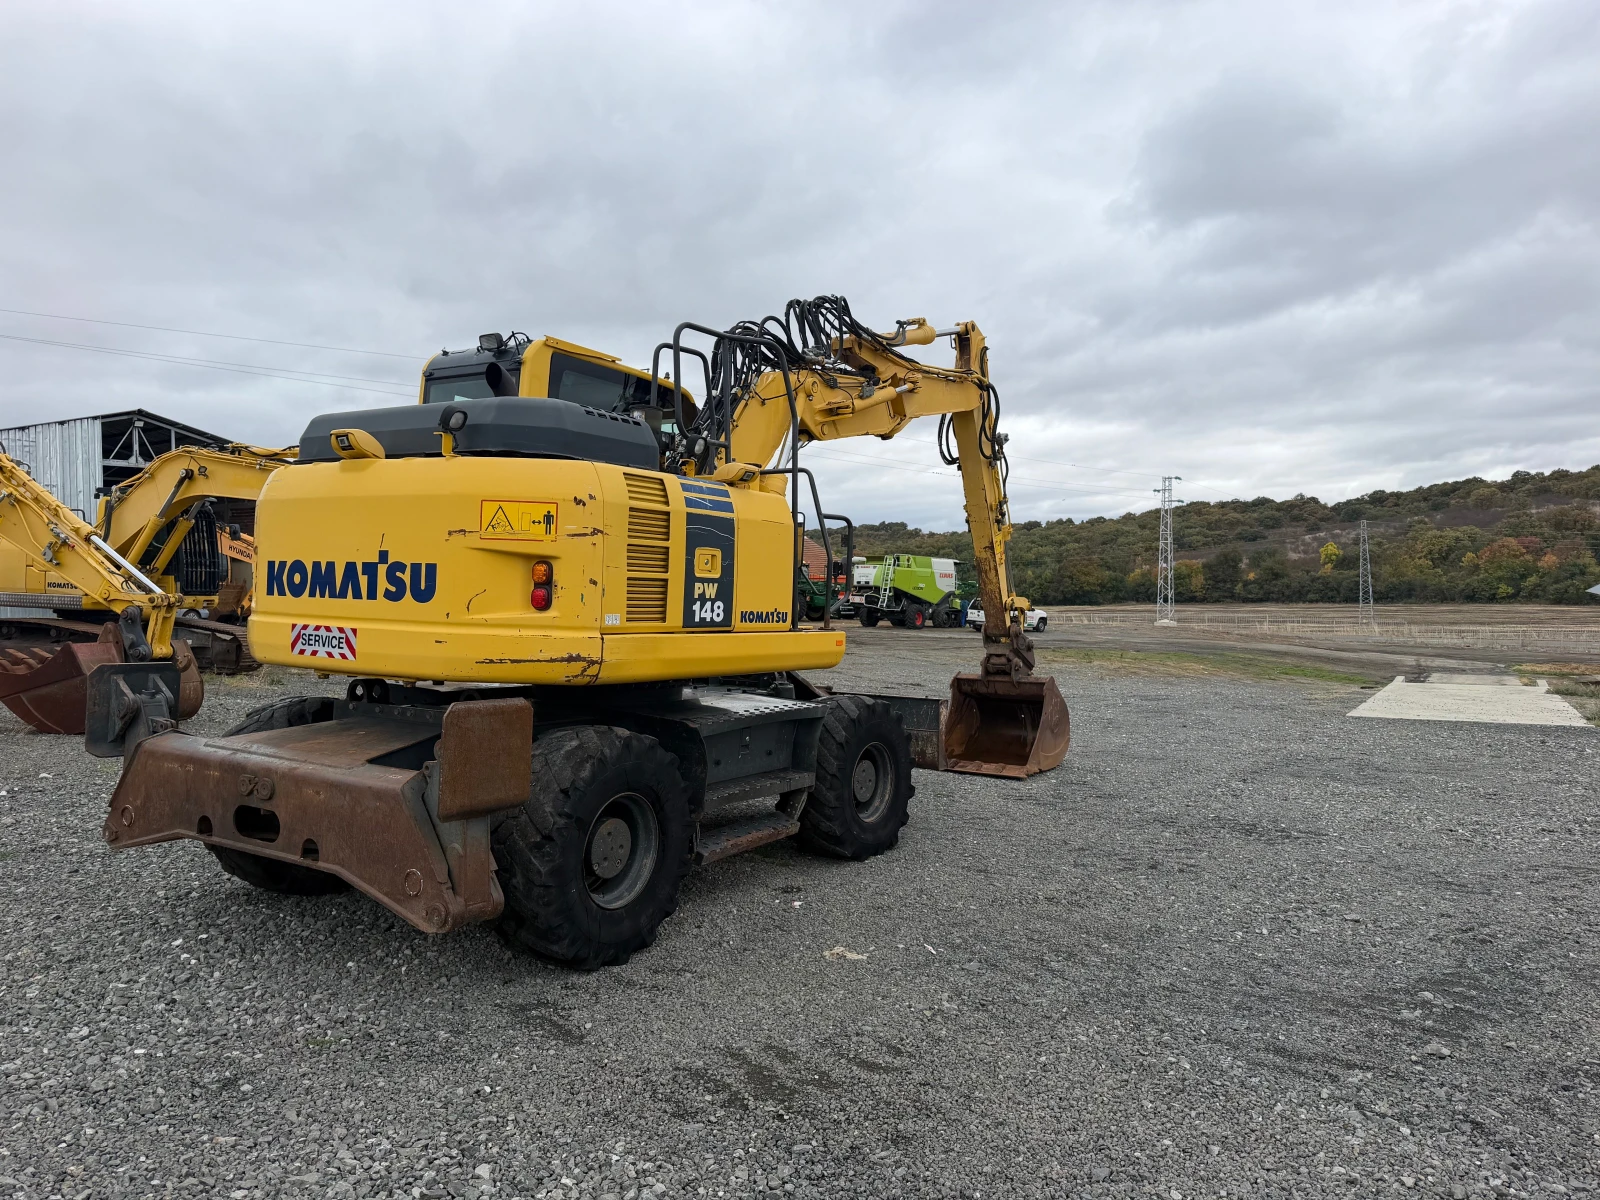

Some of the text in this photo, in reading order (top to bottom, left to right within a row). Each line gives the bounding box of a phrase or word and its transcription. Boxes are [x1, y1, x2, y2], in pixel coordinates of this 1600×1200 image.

[228, 544, 253, 560] HYUNDAI
[266, 550, 437, 603] KOMATSU
[694, 583, 718, 599] PW
[692, 601, 724, 622] 148
[740, 608, 788, 624] KOMATSU
[301, 633, 345, 650] SERVICE
